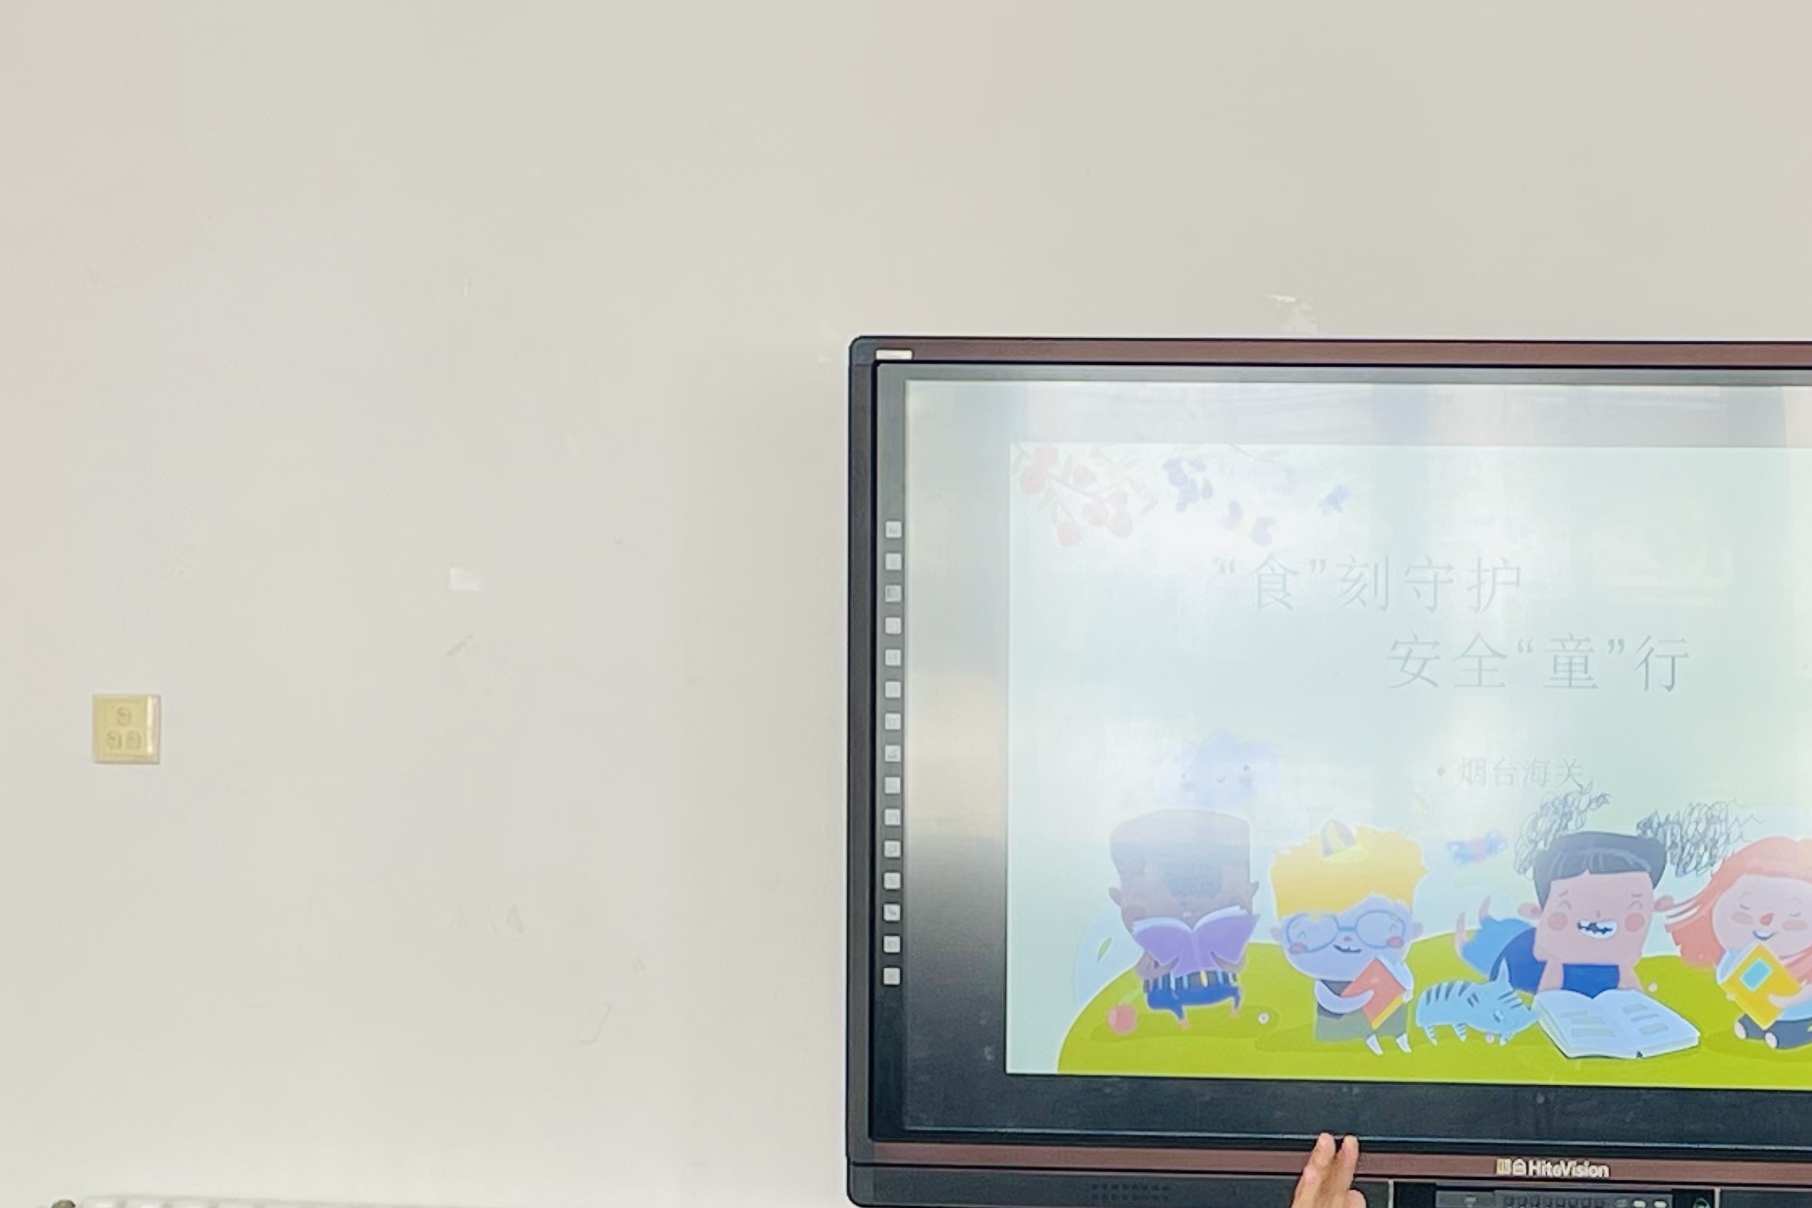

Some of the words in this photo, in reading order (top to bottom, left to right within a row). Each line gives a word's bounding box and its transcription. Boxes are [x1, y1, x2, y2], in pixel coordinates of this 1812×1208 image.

[1217, 553, 1522, 615] “食”刻守护
[1386, 630, 1691, 693] 安全“童”行
[1456, 756, 1585, 789] 烟台海关
